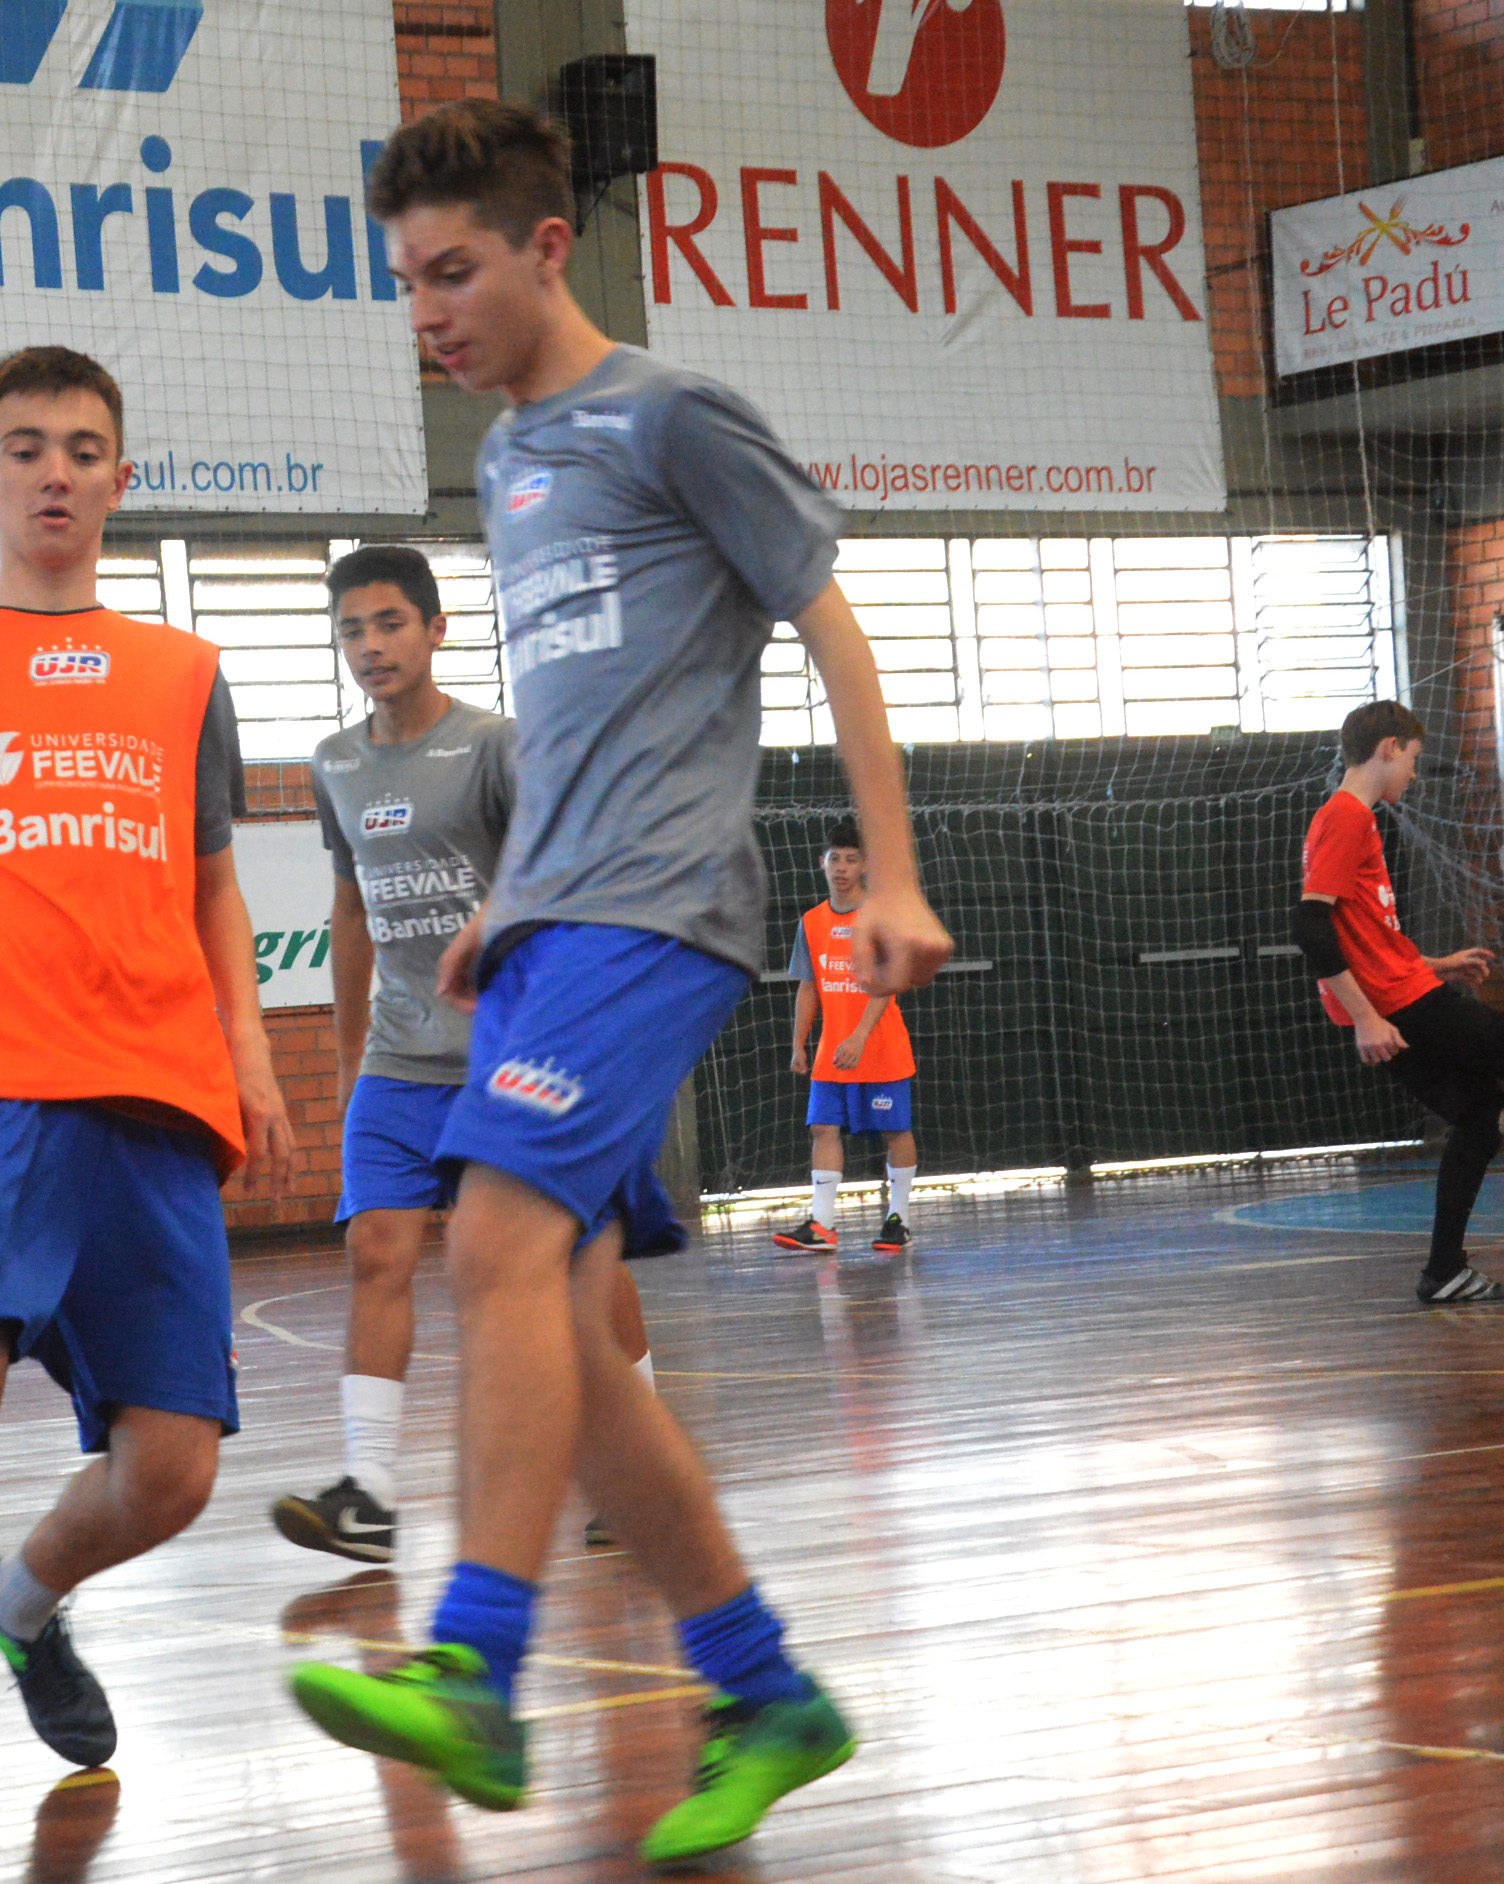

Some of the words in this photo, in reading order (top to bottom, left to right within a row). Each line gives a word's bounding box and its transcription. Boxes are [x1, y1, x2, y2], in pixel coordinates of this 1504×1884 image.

[645, 160, 1203, 321] RENNER
[1303, 289, 1350, 336] Le
[1363, 259, 1471, 323] Padú
[797, 453, 1156, 500] w.lojasrenner.com.br
[367, 854, 472, 878] UNIVERSDADE
[370, 866, 476, 901] FEEVALE
